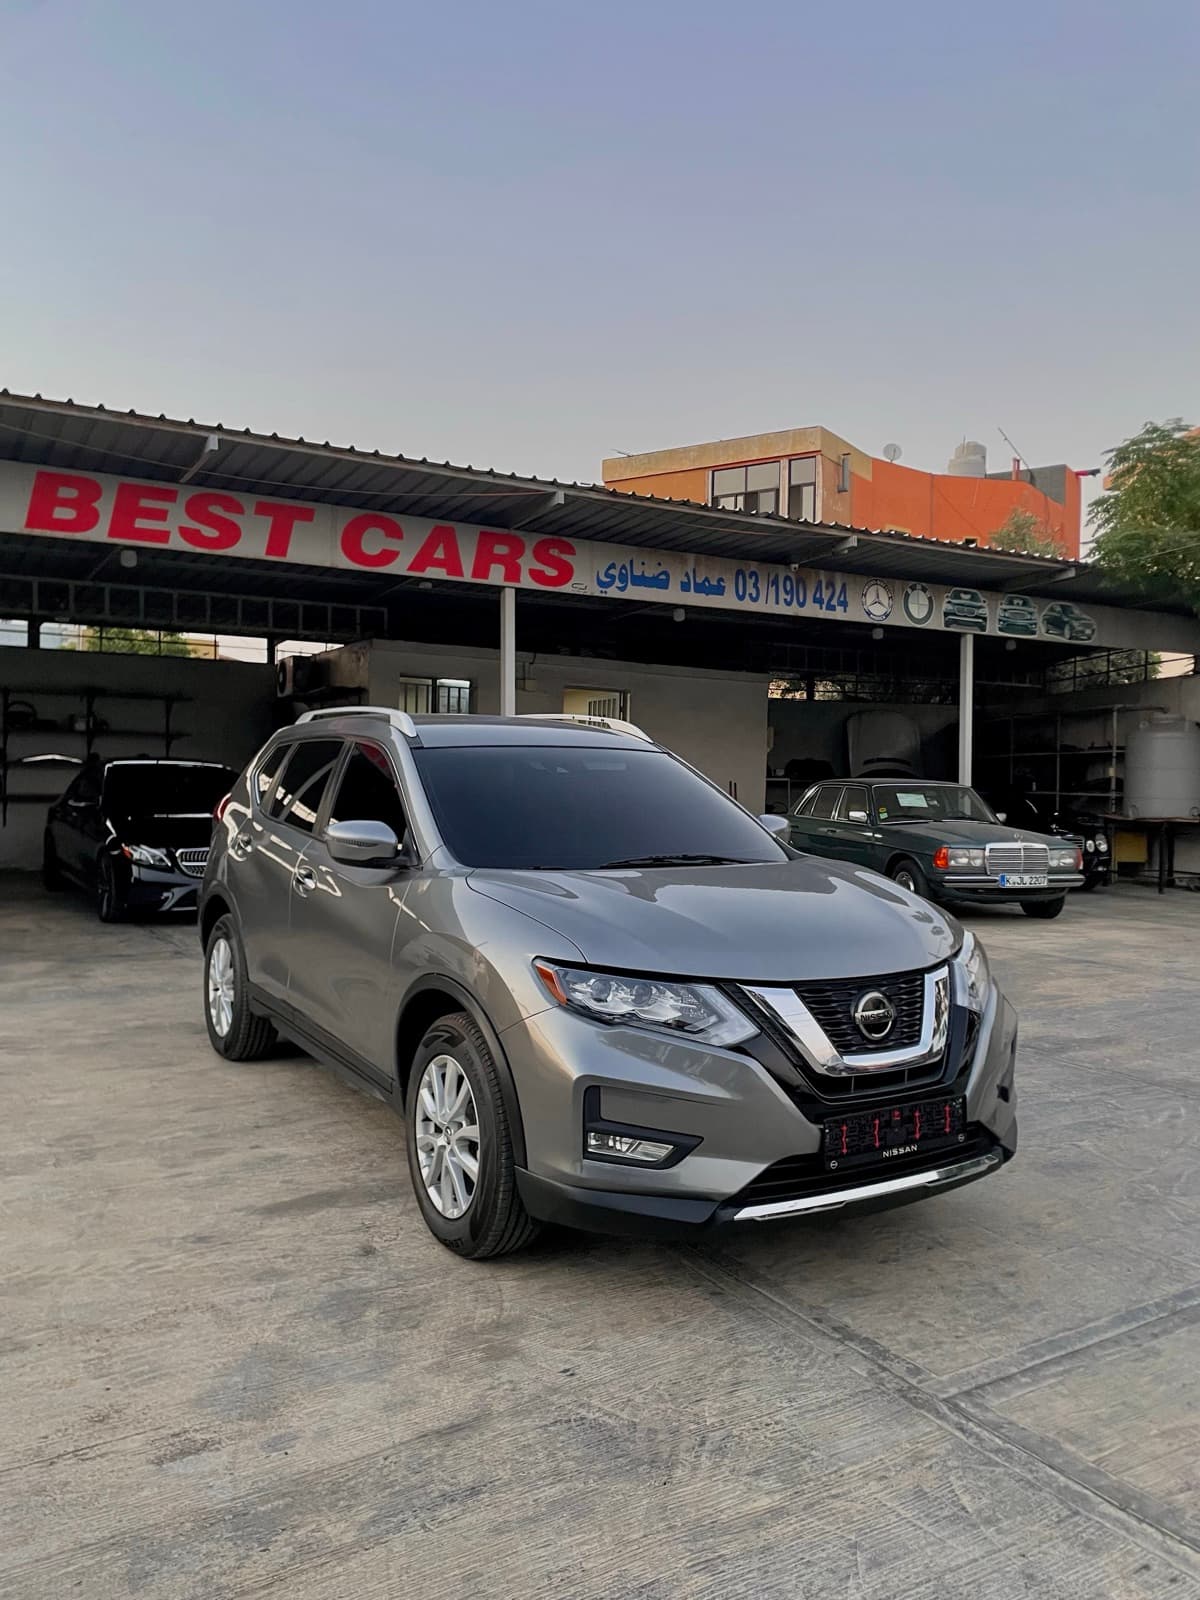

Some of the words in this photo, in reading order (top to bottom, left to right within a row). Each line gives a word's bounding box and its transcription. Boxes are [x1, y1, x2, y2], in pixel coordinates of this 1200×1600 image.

[24, 470, 315, 558] BEST
[340, 512, 577, 588] CARS
[596, 557, 671, 595] ضناوي
[679, 567, 727, 597] عماد
[734, 568, 761, 603] 03
[812, 578, 849, 614] 424
[882, 1143, 918, 1158] NISSAN
